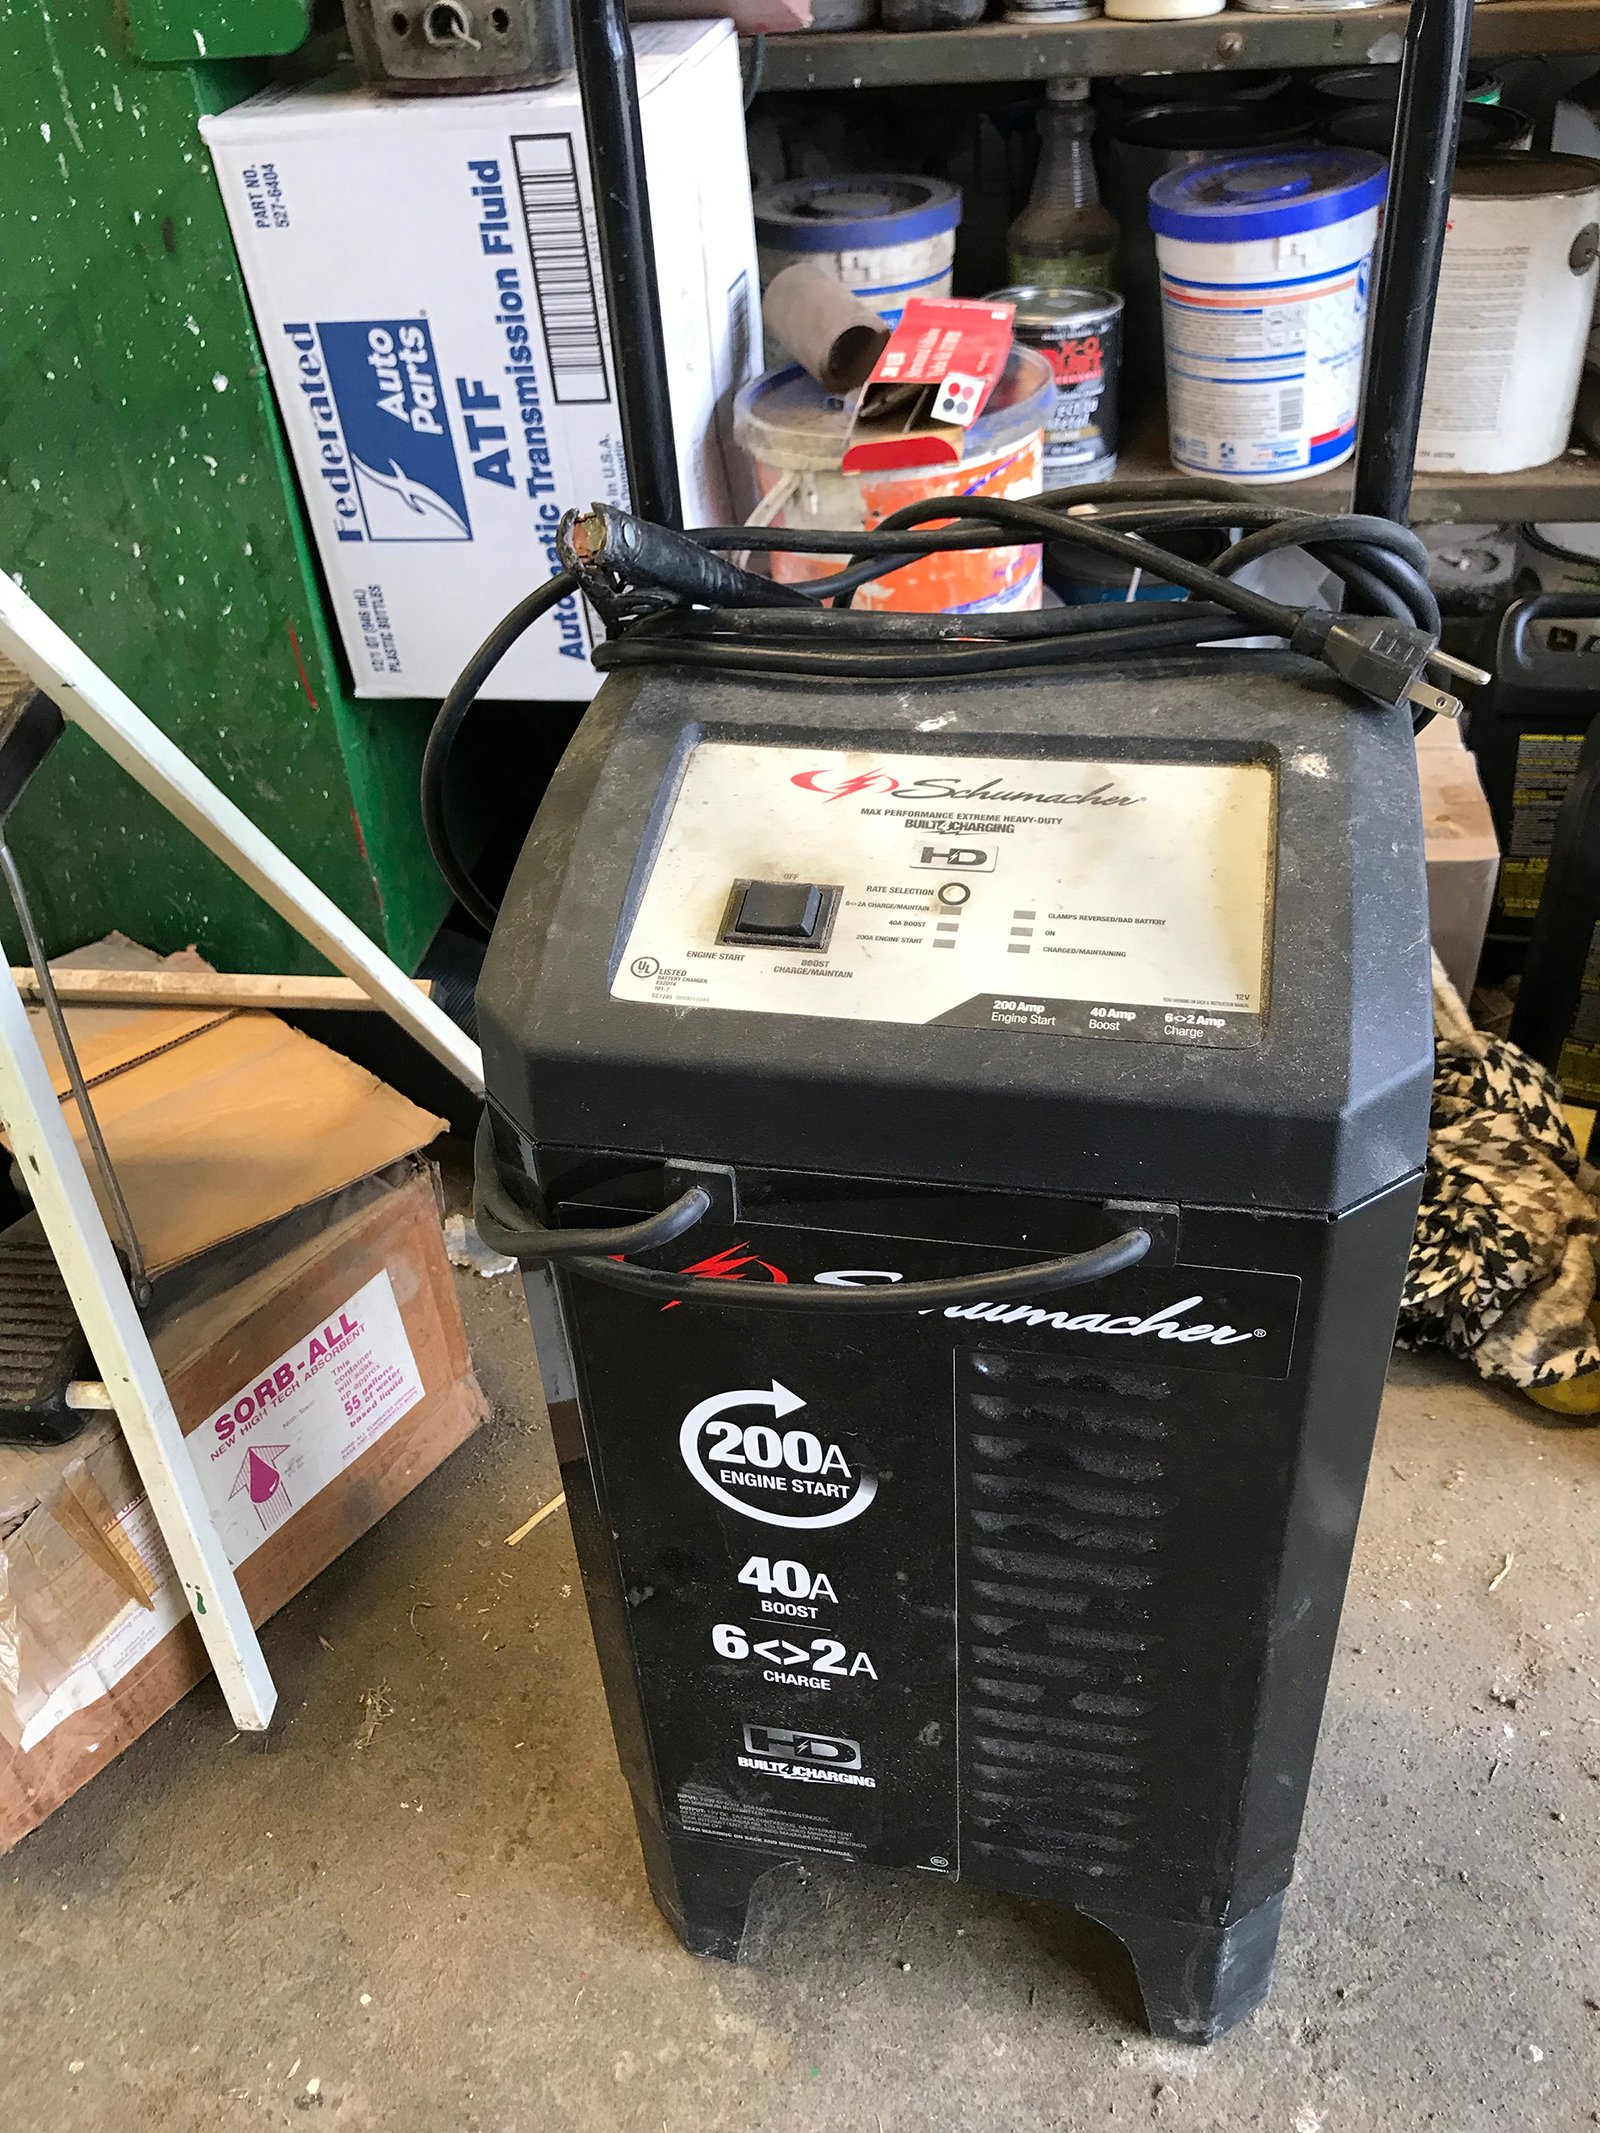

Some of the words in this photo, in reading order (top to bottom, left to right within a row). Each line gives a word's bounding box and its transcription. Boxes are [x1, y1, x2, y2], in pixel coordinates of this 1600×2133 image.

[243, 164, 260, 188] NO.
[261, 164, 289, 228] 527-6404
[467, 160, 513, 256] Fluid
[248, 192, 271, 228] PART
[368, 327, 410, 424] Auto
[398, 326, 444, 435] Parts
[495, 268, 556, 499] Transmission
[283, 323, 363, 541] Federated
[456, 377, 516, 489] ATF
[368, 584, 391, 630] BOTTLES
[891, 778, 1142, 807] Schumacher
[861, 807, 883, 817] MAX
[884, 808, 955, 820] PERFORMANCE
[956, 812, 1001, 822] EXTREME
[1003, 814, 1063, 825] HEAVY-DUTY
[920, 845, 987, 867] HD
[866, 885, 887, 894] RATE
[889, 886, 934, 896] SELECTION
[867, 901, 930, 912] CHARGE/MAINTAIN
[1048, 912, 1078, 923] CLAMPS
[1078, 914, 1133, 925] REVERSED/BAD
[1134, 917, 1167, 926] BATTERY
[875, 935, 900, 943] ENGINE
[686, 950, 717, 960] ENGINE
[719, 952, 746, 962] START
[801, 959, 830, 968] BOOST
[1042, 946, 1127, 958] CHARGED/MAINTAINING
[637, 960, 651, 974] UL
[659, 968, 687, 977] LISTED
[773, 965, 854, 979] CHARGE/MAINTAIN
[993, 999, 1016, 1011] 200
[1016, 1001, 1045, 1015] Amp
[1235, 993, 1250, 1001] 12V
[991, 1011, 1028, 1026] Engine
[1030, 1014, 1056, 1026] Start
[1089, 1018, 1121, 1031] Boost
[1090, 1006, 1106, 1018] 40
[1106, 1008, 1137, 1022] Amp
[1195, 1015, 1226, 1029] Amp
[1163, 1024, 1204, 1039] Charge
[331, 1360, 351, 1377] This
[334, 1349, 373, 1386] container
[338, 1377, 352, 1393] will
[354, 1360, 374, 1379] soak
[210, 1434, 236, 1462] NEW
[240, 1407, 268, 1436] HIGH
[270, 1381, 300, 1409] TECH
[304, 1323, 366, 1383] ABSORBENT
[340, 1390, 352, 1402] up
[354, 1363, 382, 1391] approx.
[344, 1394, 362, 1416] 55
[362, 1364, 394, 1396] gallons
[365, 1392, 374, 1403] of
[375, 1368, 401, 1393] water
[350, 1400, 378, 1428] based
[379, 1375, 404, 1402] liquid
[704, 1420, 853, 1478] 200A
[719, 1469, 787, 1492] ENGINE
[791, 1479, 851, 1499] START
[737, 1555, 839, 1604] 40A
[760, 1599, 819, 1620] BOOST
[711, 1622, 879, 1681] 6<>2A
[763, 1669, 832, 1691] CHARGE
[750, 1728, 858, 1763] HD
